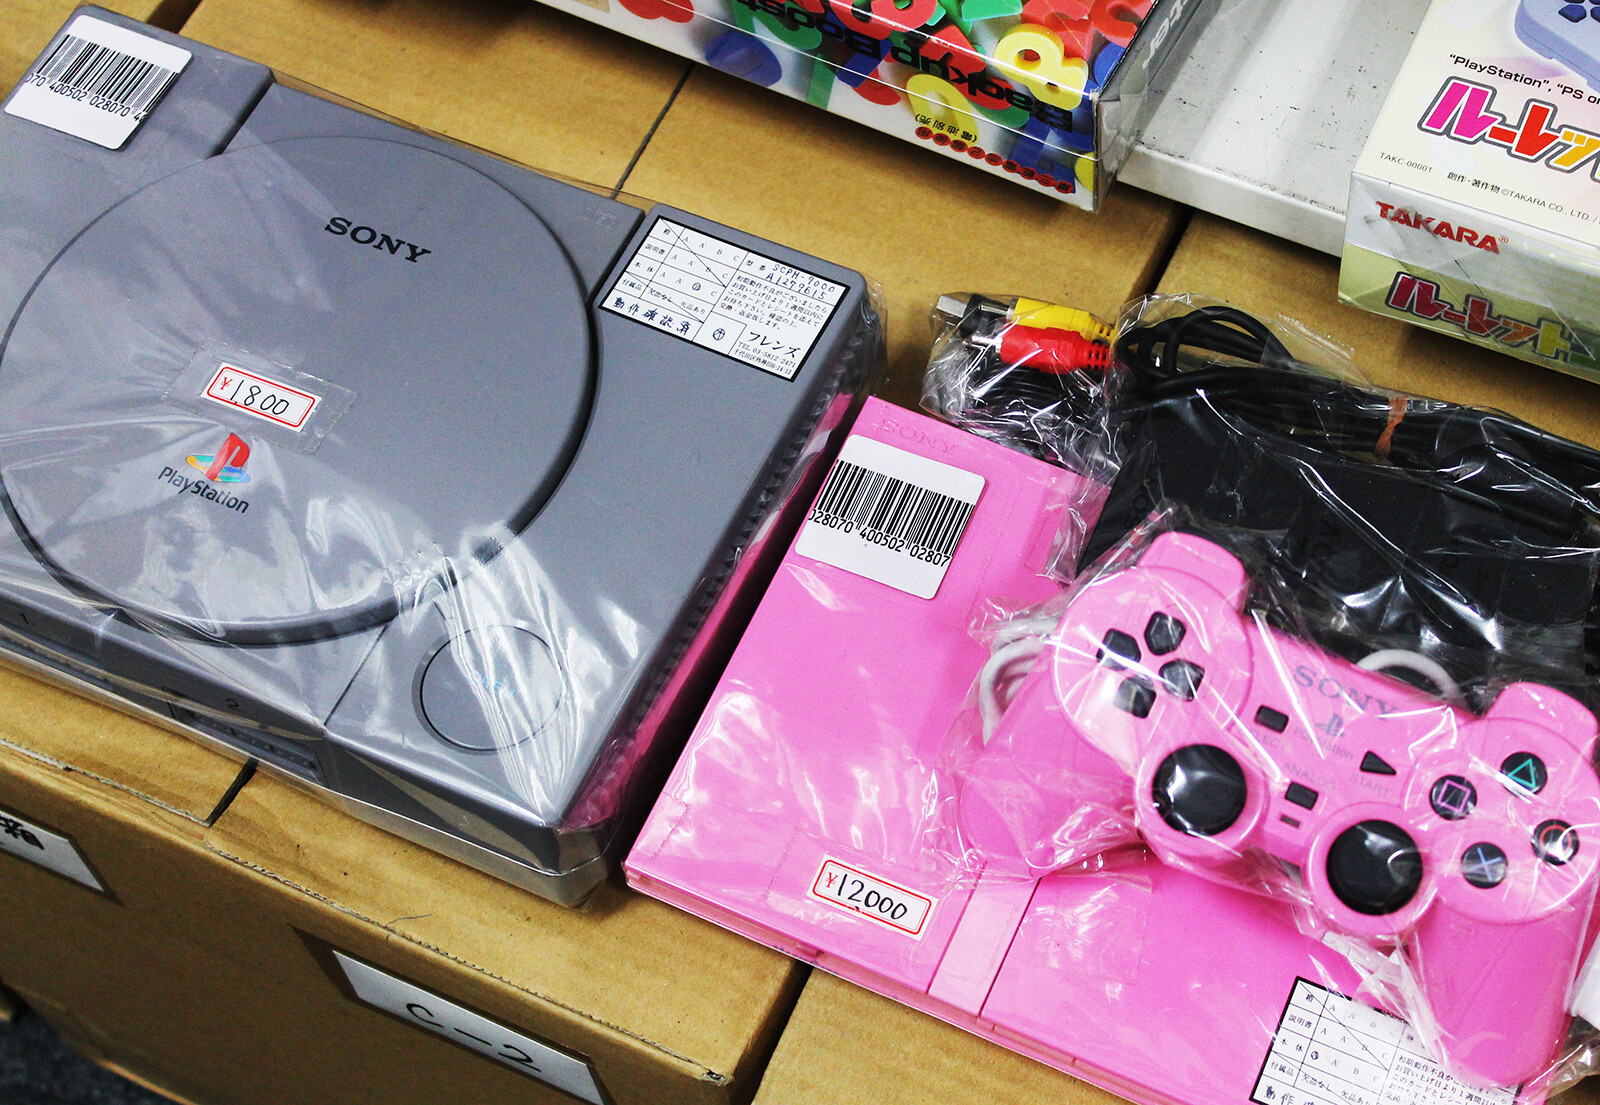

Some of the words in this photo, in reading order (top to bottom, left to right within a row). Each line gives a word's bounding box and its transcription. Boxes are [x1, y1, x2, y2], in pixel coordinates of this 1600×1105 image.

[49, 82, 88, 102] 400502
[89, 96, 131, 117] 028070
[890, 30, 1073, 132] Backup
[1417, 75, 1600, 183] ルーレッ
[1379, 151, 1433, 174] TAKC-00001
[324, 216, 432, 263] SONY
[747, 331, 801, 358] フレンズ
[881, 417, 961, 453] SONY
[158, 465, 250, 514] PlayStation
[859, 527, 905, 553] 400502
[909, 545, 951, 567] 02807
[1293, 664, 1398, 722] SONY
